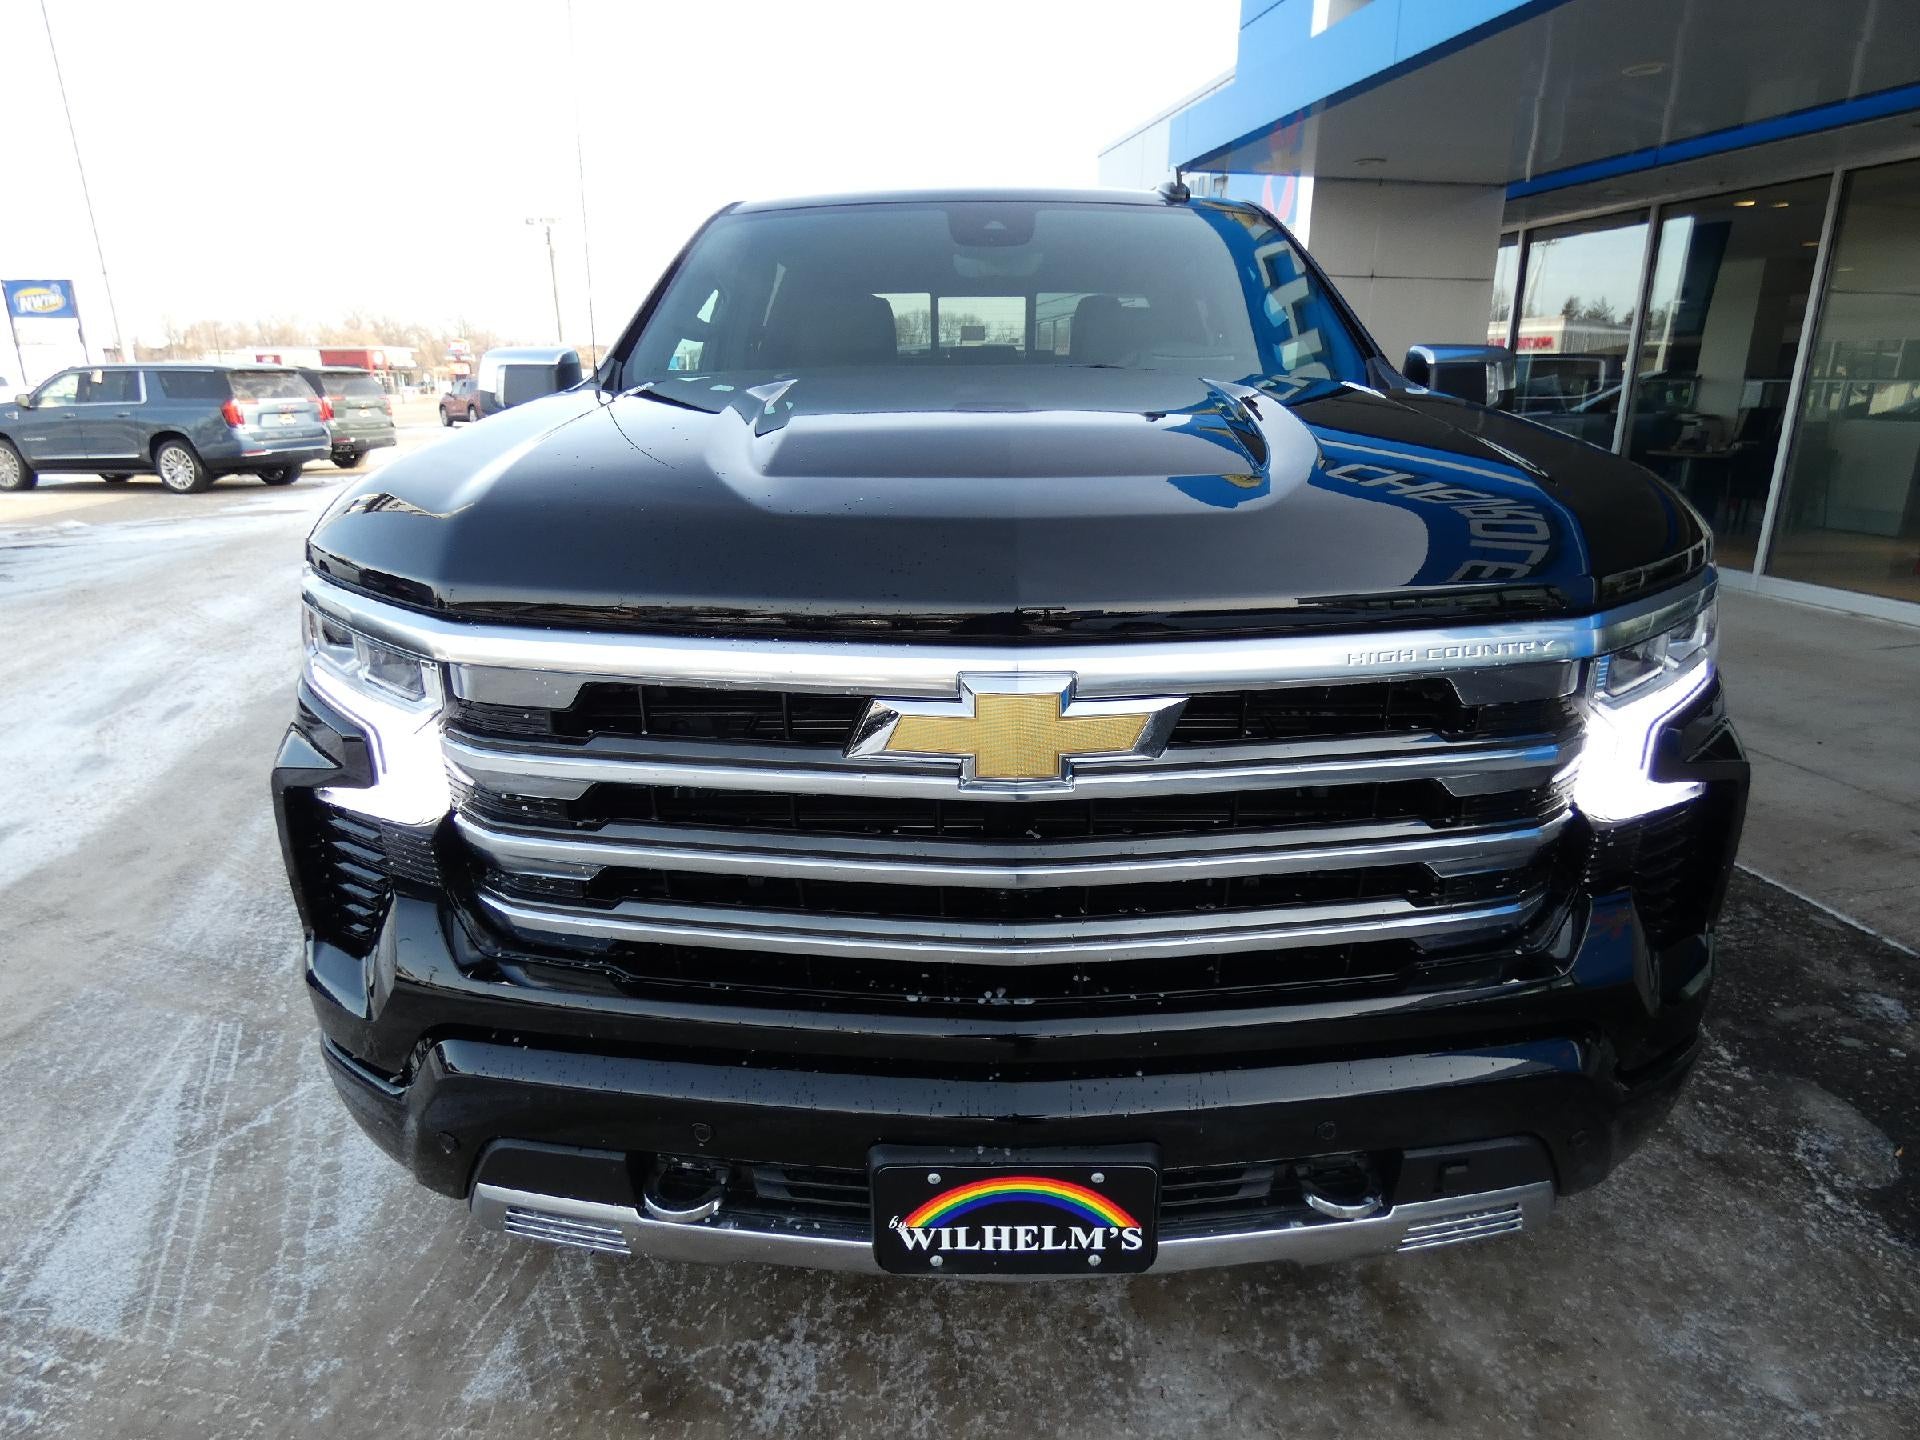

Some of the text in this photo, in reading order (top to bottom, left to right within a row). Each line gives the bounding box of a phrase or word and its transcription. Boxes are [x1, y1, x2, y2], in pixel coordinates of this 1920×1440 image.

[1347, 640, 1555, 666] HIGH COUNTRY
[896, 1225, 1143, 1251] WILHELM'S
